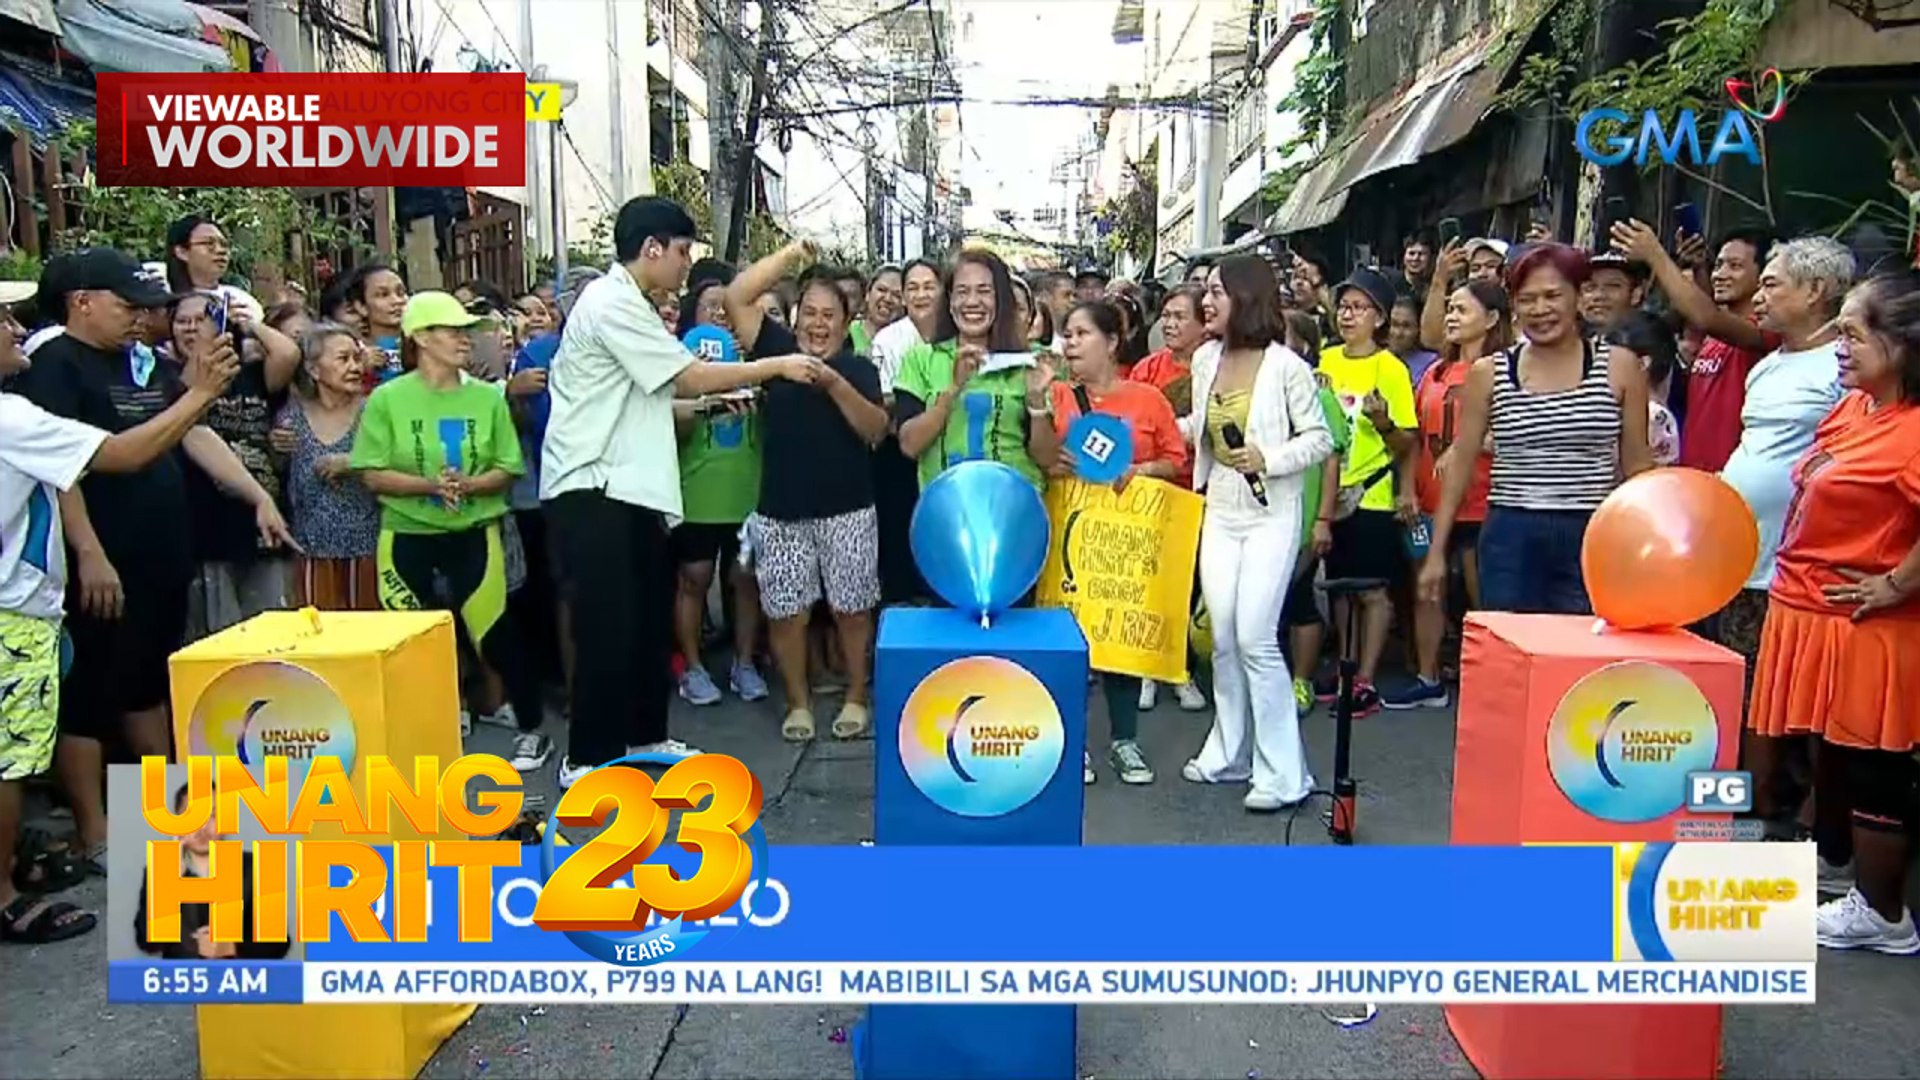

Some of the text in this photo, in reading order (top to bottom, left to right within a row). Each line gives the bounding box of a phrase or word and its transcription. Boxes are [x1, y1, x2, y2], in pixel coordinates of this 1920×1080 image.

[703, 342, 720, 356] 16
[1087, 436, 1107, 458] 11
[262, 728, 330, 743] UNANG
[971, 725, 1040, 741] UNANG
[1622, 730, 1692, 745] UNANG
[263, 745, 317, 760] HIRIT
[971, 742, 1024, 757] HIRIT
[1621, 746, 1676, 762] HIRIT
